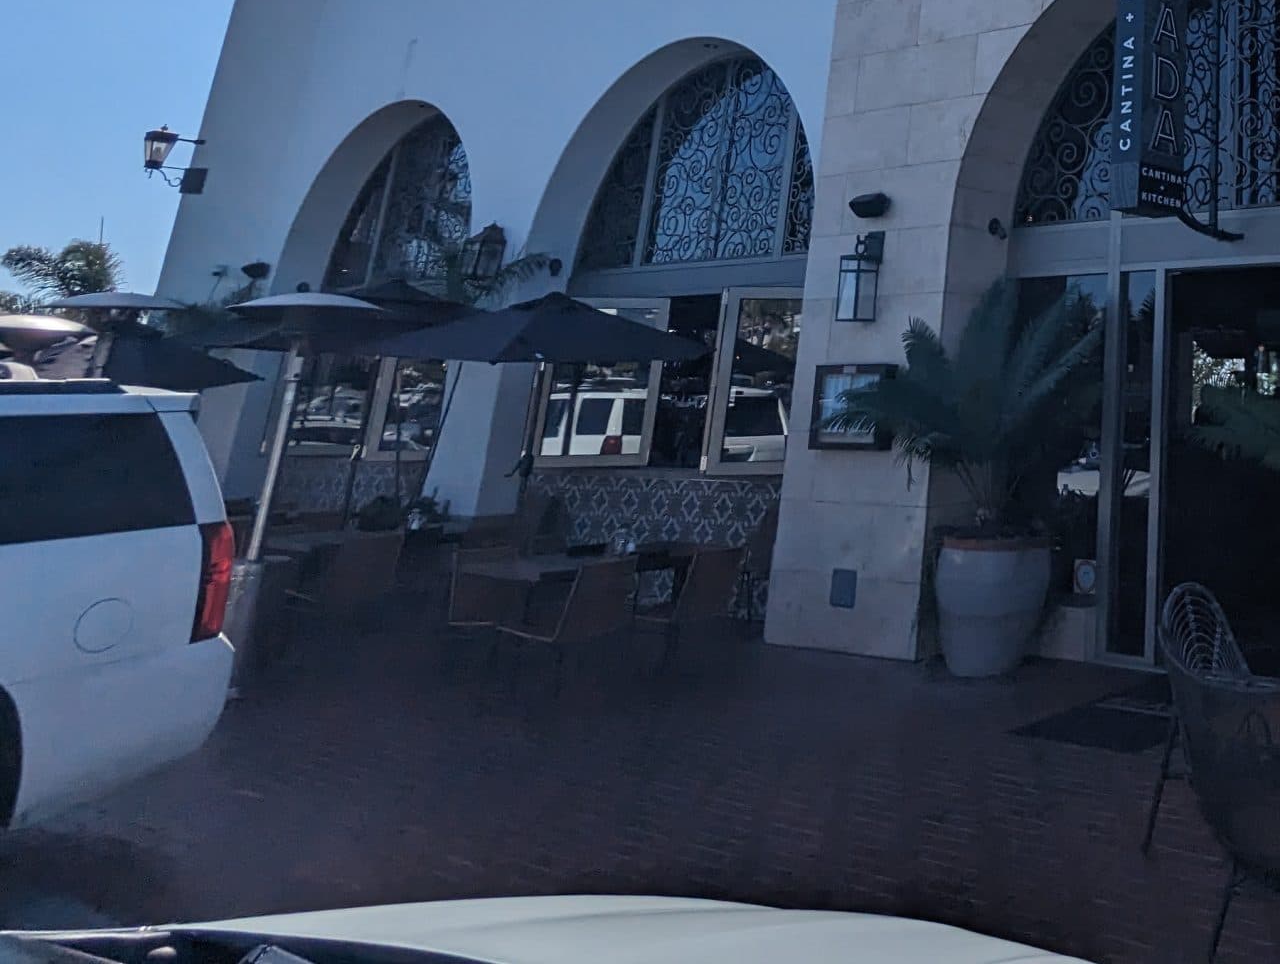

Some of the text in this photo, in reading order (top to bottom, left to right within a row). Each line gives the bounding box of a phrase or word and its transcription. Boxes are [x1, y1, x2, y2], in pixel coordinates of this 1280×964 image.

[1119, 36, 1135, 152] CANTINA
[1142, 167, 1183, 185] CANTINA
[1141, 191, 1182, 208] KITCHEN
